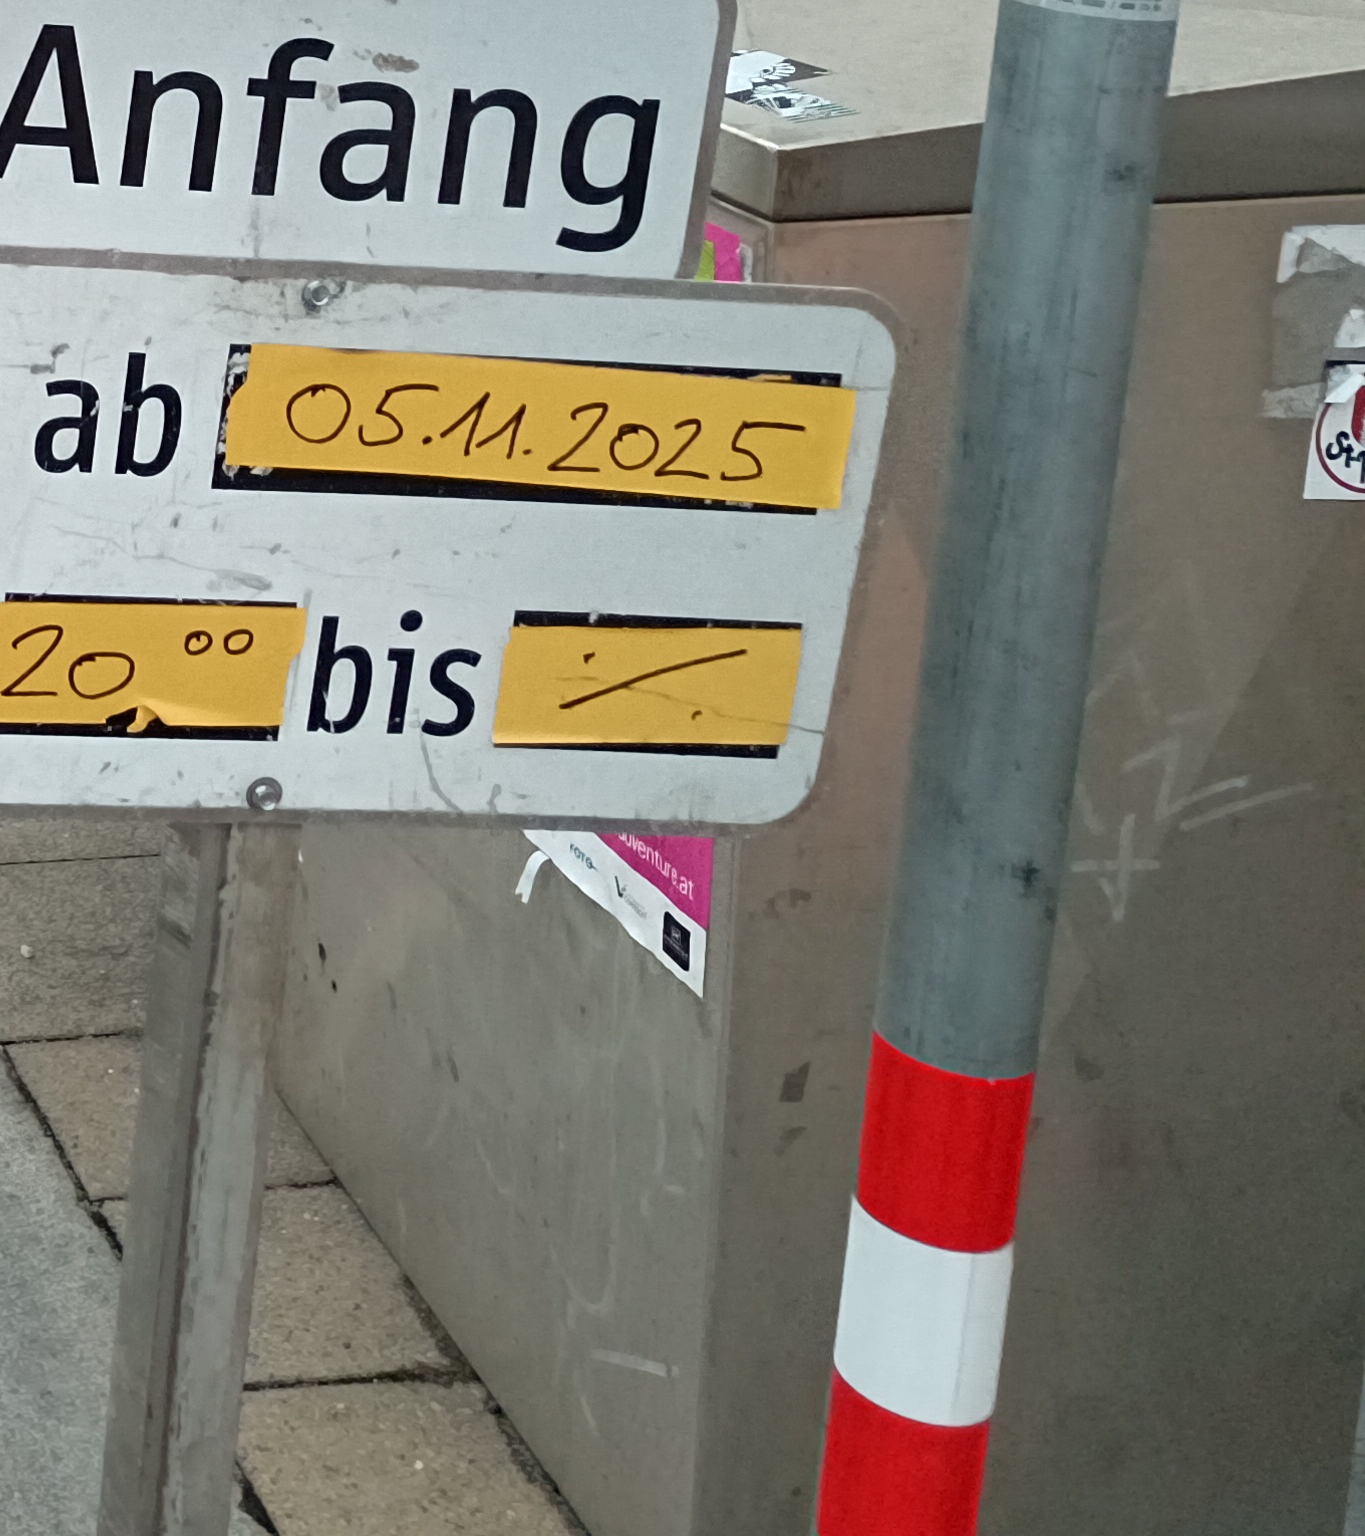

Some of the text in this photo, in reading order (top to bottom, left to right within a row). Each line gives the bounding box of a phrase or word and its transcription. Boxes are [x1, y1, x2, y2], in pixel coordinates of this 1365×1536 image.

[34, 351, 183, 478] ab
[285, 383, 807, 482] 05.11.2025
[306, 609, 483, 738] bis
